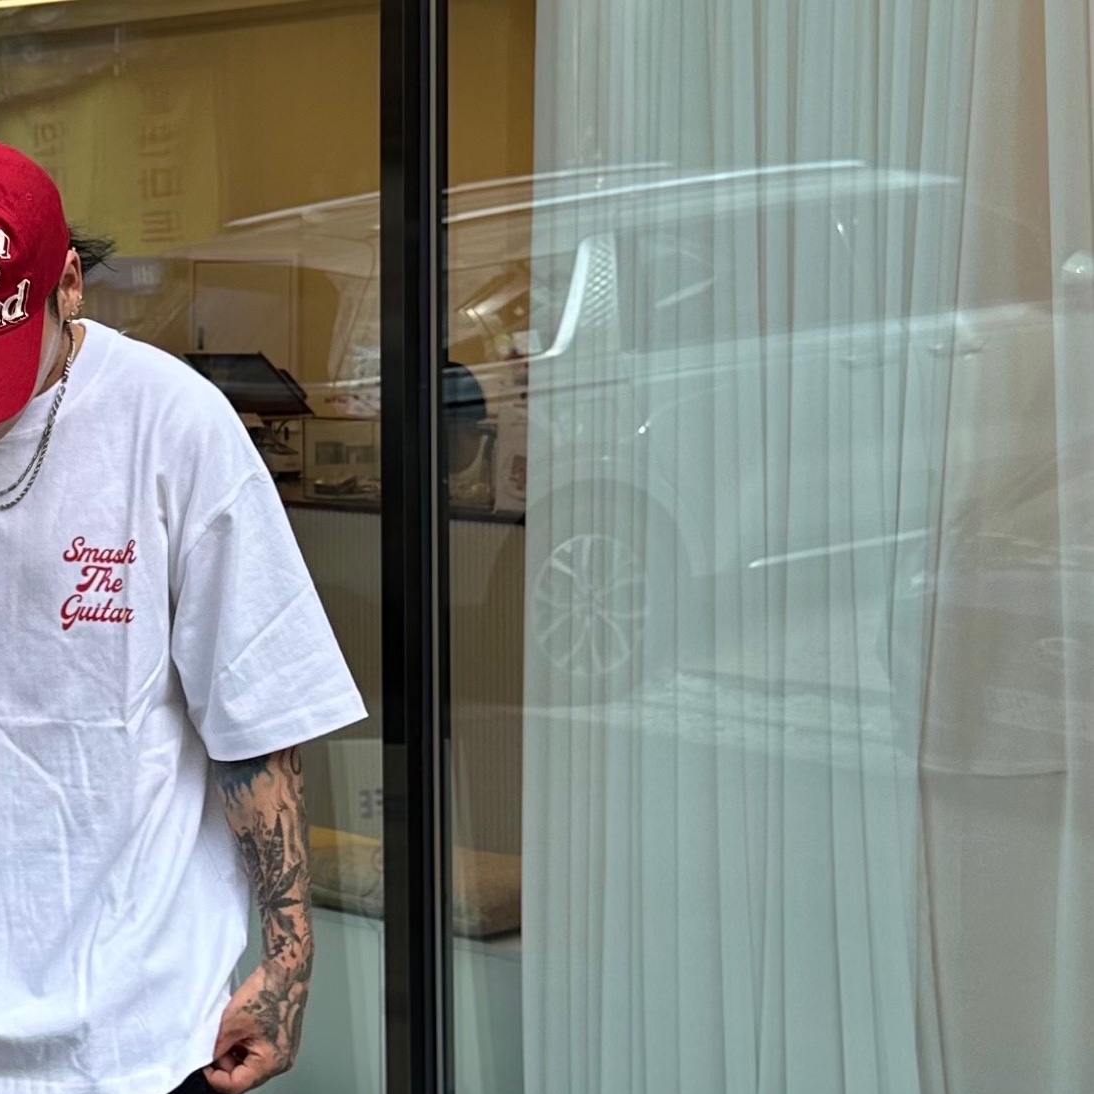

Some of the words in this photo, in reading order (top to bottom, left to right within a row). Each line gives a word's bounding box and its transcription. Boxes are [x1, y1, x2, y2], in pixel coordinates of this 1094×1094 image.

[63, 536, 137, 564] Smash
[76, 565, 123, 593] The
[60, 594, 135, 631] Guitar
